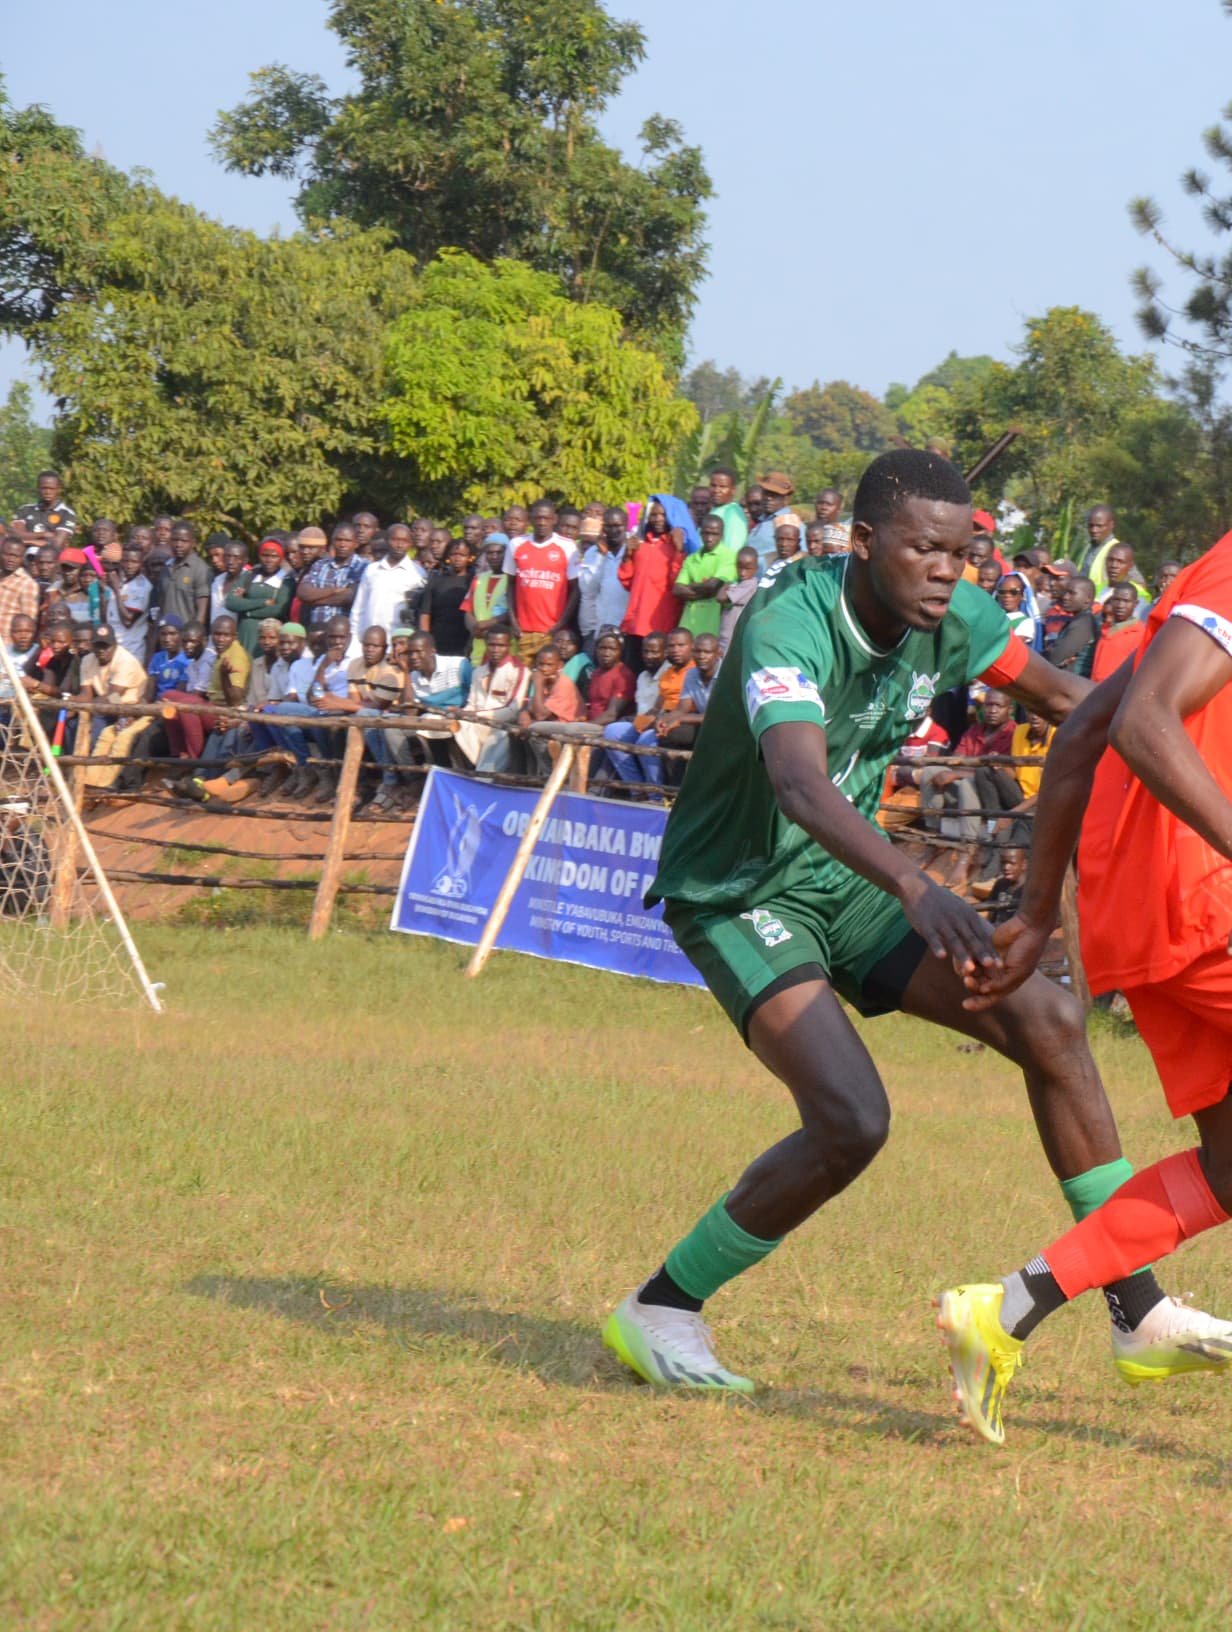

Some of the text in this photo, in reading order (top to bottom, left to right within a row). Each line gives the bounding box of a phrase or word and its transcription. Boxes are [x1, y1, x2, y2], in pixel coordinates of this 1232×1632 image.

[523, 854, 607, 893] KINDOM
[610, 868, 640, 897] OF
[562, 921, 576, 935] OF
